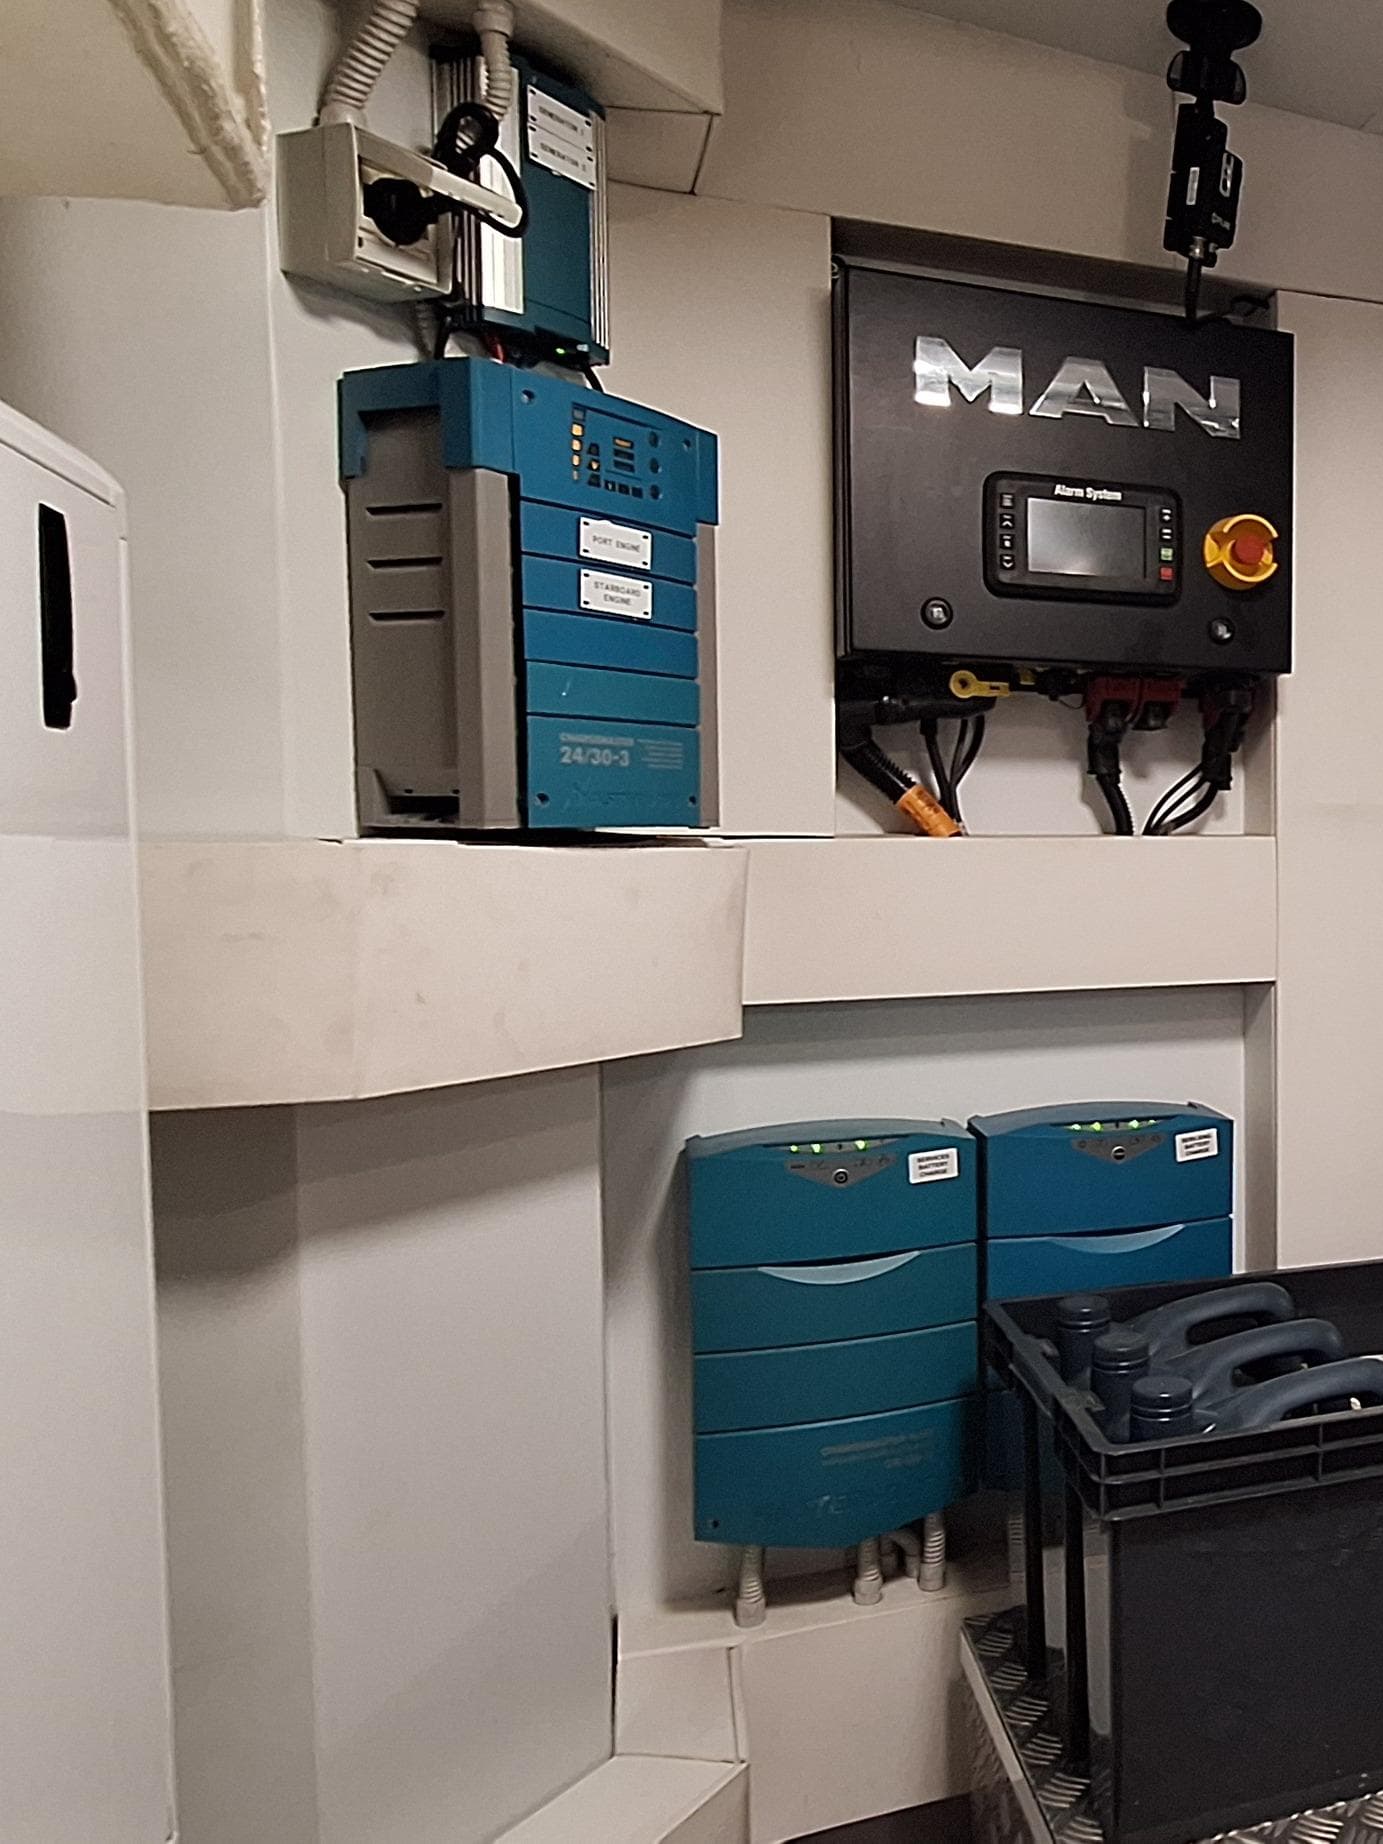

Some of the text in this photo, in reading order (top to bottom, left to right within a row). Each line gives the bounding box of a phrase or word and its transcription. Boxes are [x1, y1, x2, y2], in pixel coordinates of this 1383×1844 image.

[913, 335, 1242, 440] MAN
[1054, 484, 1122, 501] Alarm System
[592, 535, 641, 553] PORT ENGINE
[594, 581, 641, 597] STARBOARD
[604, 594, 632, 606] ENGINE
[559, 745, 630, 767] 24/30-3
